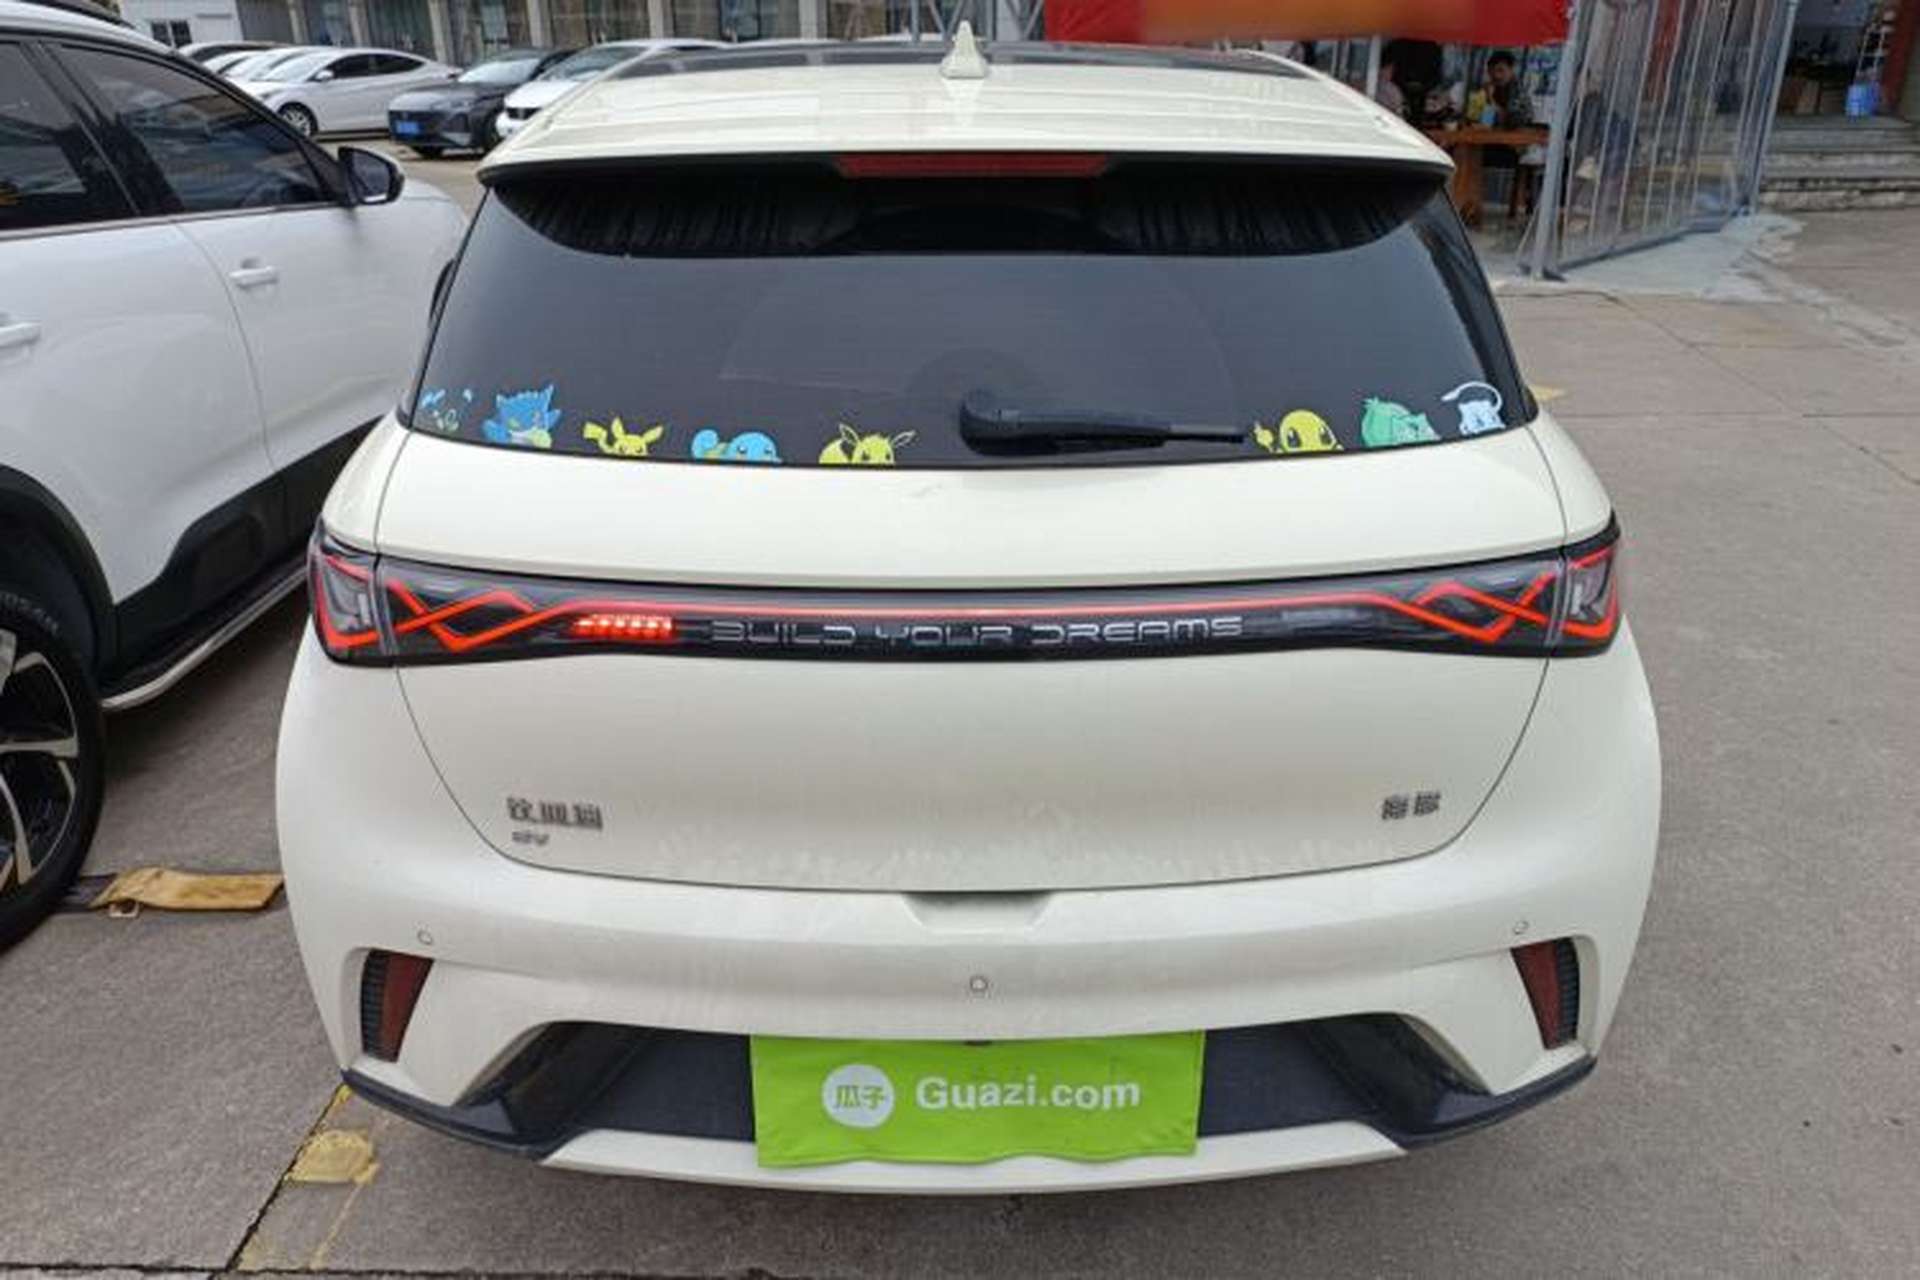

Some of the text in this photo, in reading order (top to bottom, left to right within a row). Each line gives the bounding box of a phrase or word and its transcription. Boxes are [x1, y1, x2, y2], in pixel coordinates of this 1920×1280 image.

[712, 616, 1243, 646] BUILD YOUR DREAMS
[834, 1084, 885, 1110] 瓜子
[915, 1074, 1141, 1111] Guazi.com
